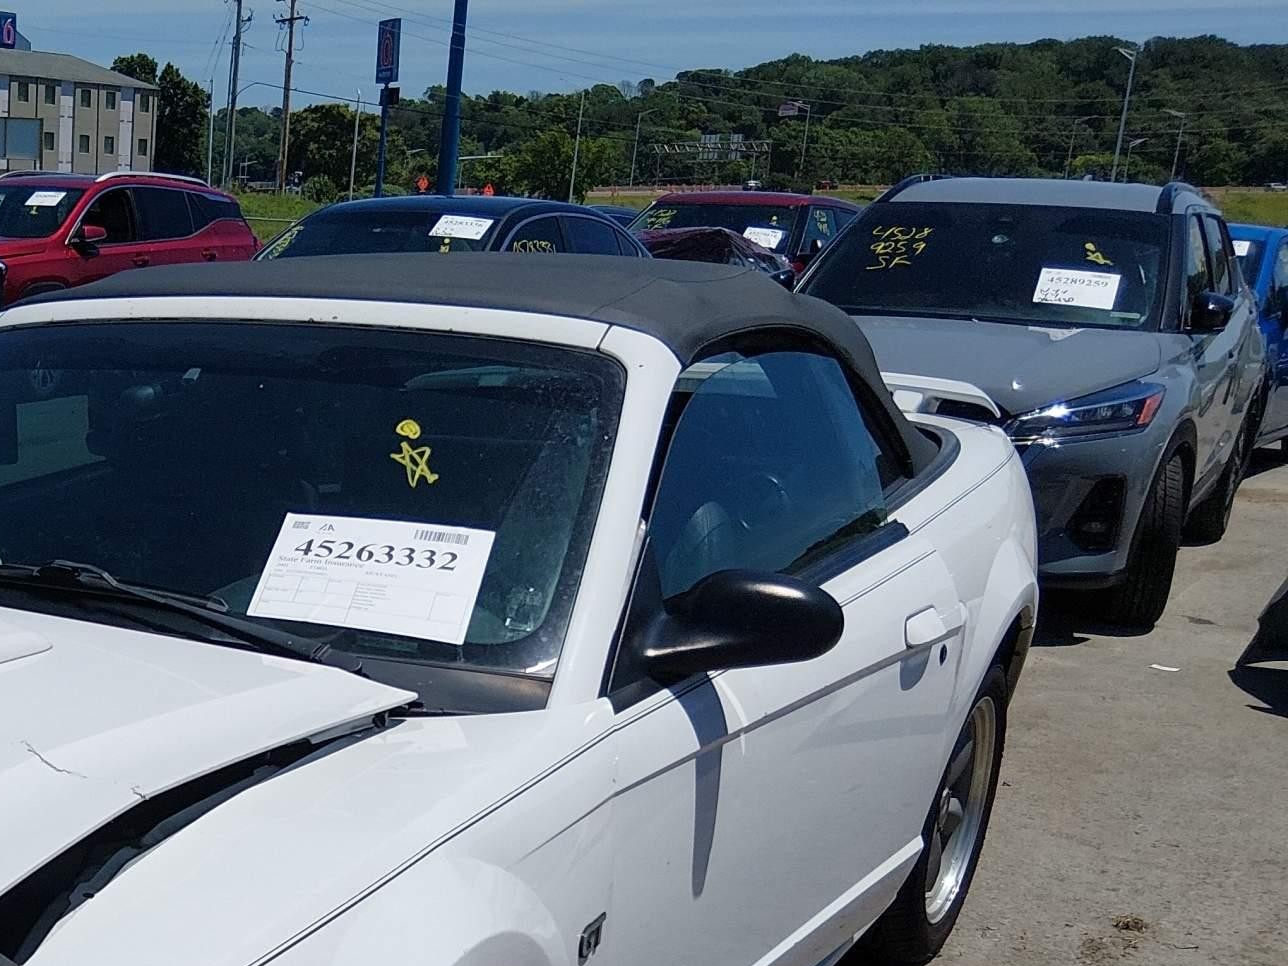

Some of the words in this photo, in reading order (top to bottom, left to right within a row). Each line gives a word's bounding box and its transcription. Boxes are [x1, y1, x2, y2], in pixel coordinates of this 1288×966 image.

[3, 18, 15, 45] 6
[870, 241, 927, 257] 9259
[1047, 276, 1109, 288] 45289259
[294, 538, 459, 572] 45263332
[300, 556, 322, 565] Farm
